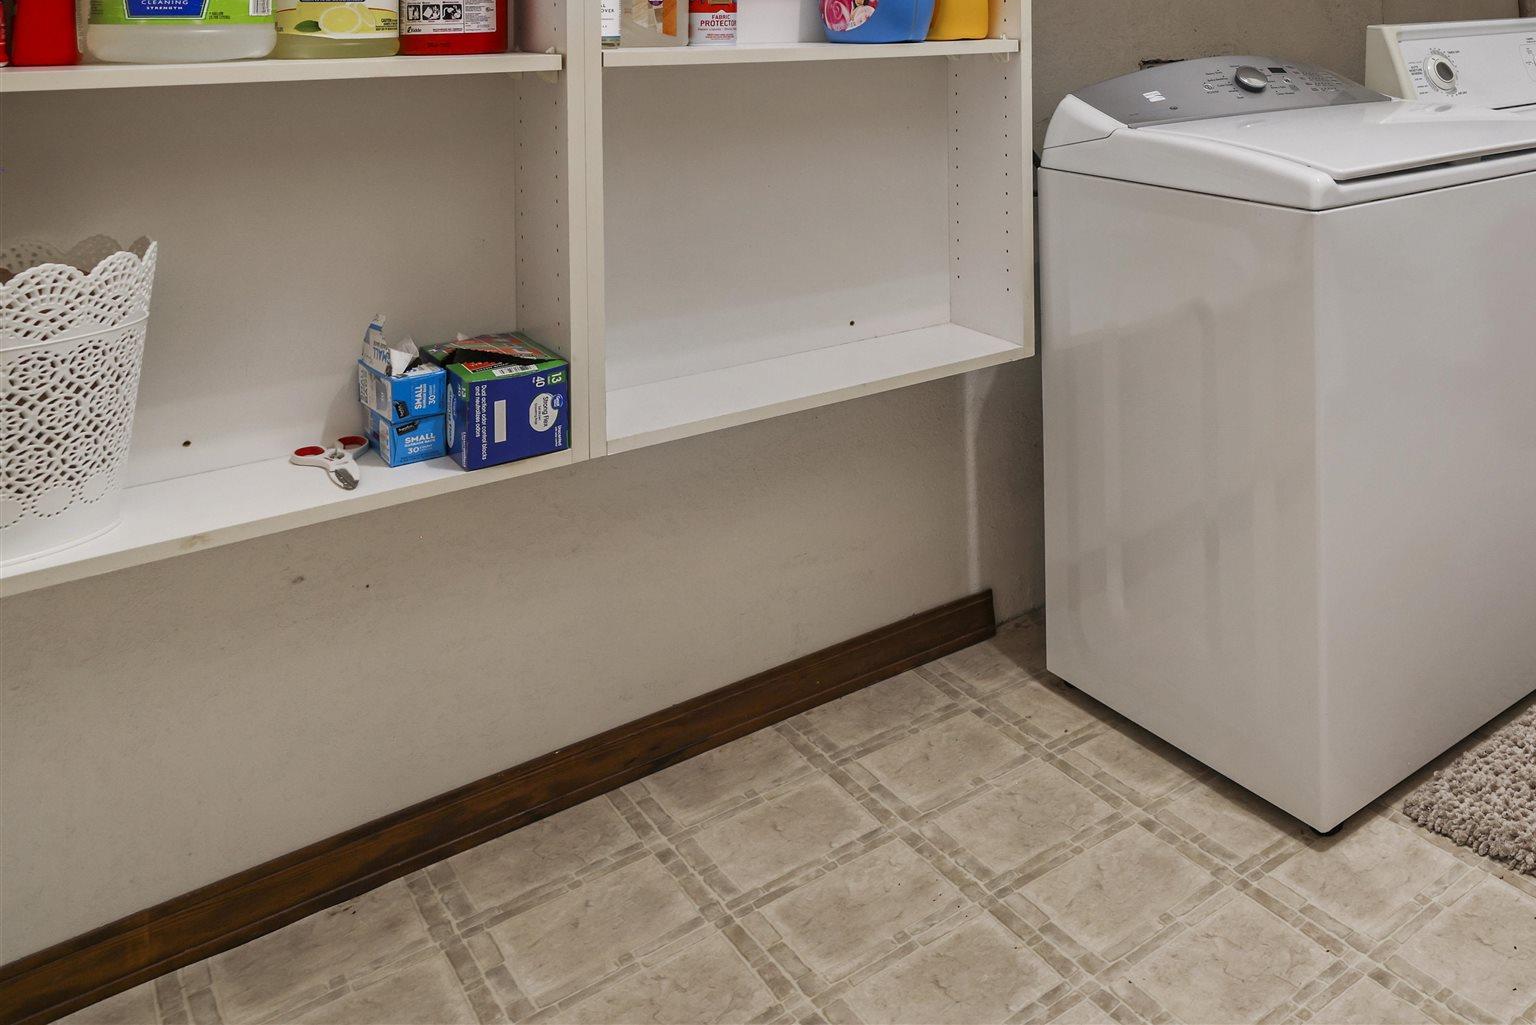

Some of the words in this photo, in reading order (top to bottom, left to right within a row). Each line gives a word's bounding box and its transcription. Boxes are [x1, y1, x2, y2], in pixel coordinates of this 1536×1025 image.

[535, 376, 545, 388] 40
[551, 372, 562, 384] 13
[414, 383, 423, 410] SMALL
[428, 394, 436, 405] 30
[404, 432, 436, 444] SMALL
[407, 446, 420, 454] 30
